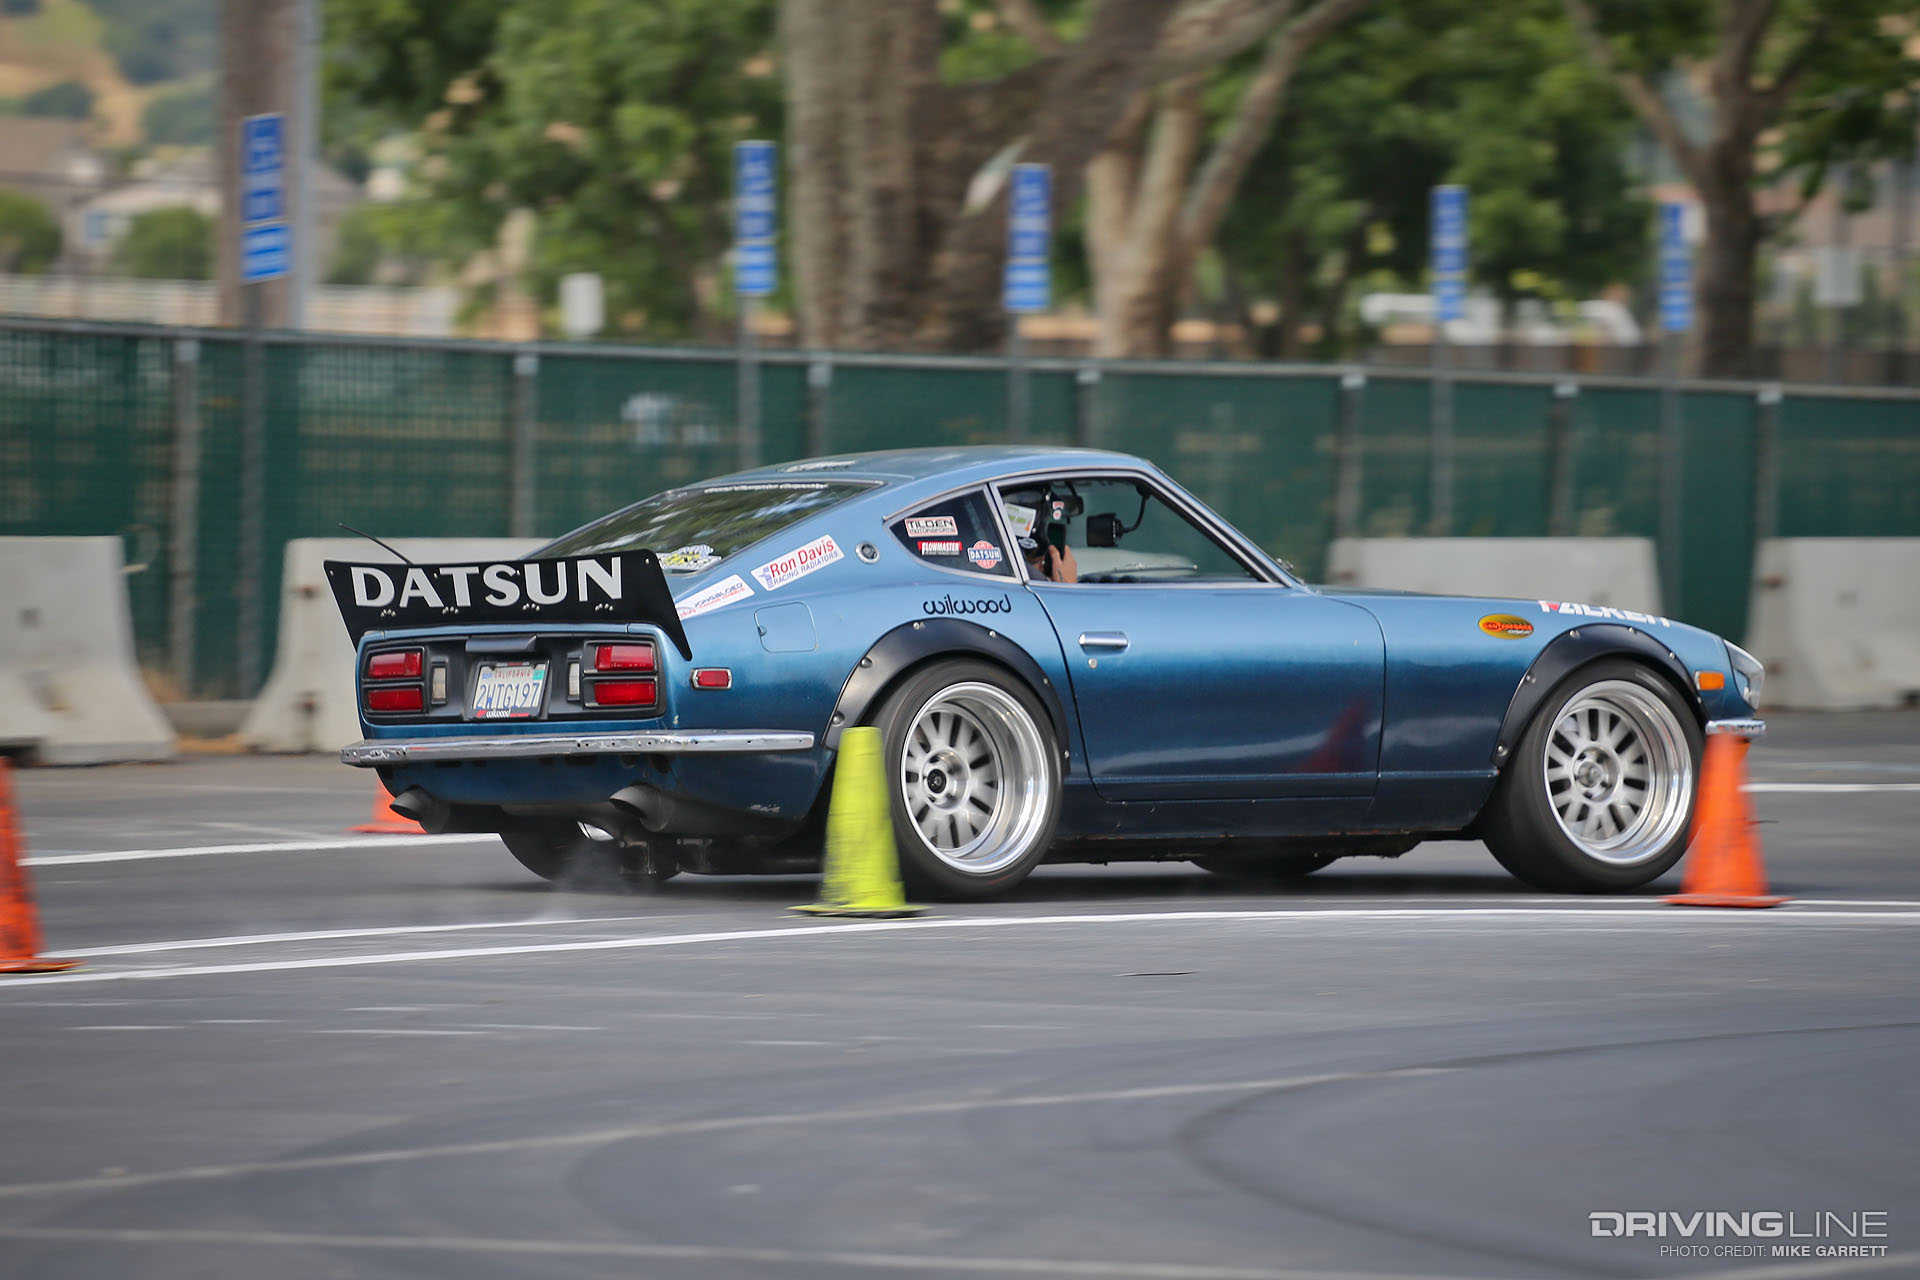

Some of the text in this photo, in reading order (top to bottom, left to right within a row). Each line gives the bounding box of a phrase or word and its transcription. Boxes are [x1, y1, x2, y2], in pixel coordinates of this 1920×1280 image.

[908, 519, 952, 528] TILDEN
[770, 539, 834, 577] Ron Davis
[922, 542, 960, 555] FLOWMASTER
[970, 549, 1000, 560] DATSUN
[773, 551, 839, 585] RACING RADIATORS
[351, 556, 622, 608] DATSUN
[923, 593, 1011, 615] wilwood
[494, 669, 531, 679] CALIFORNIA
[475, 682, 540, 710] 2WTG197
